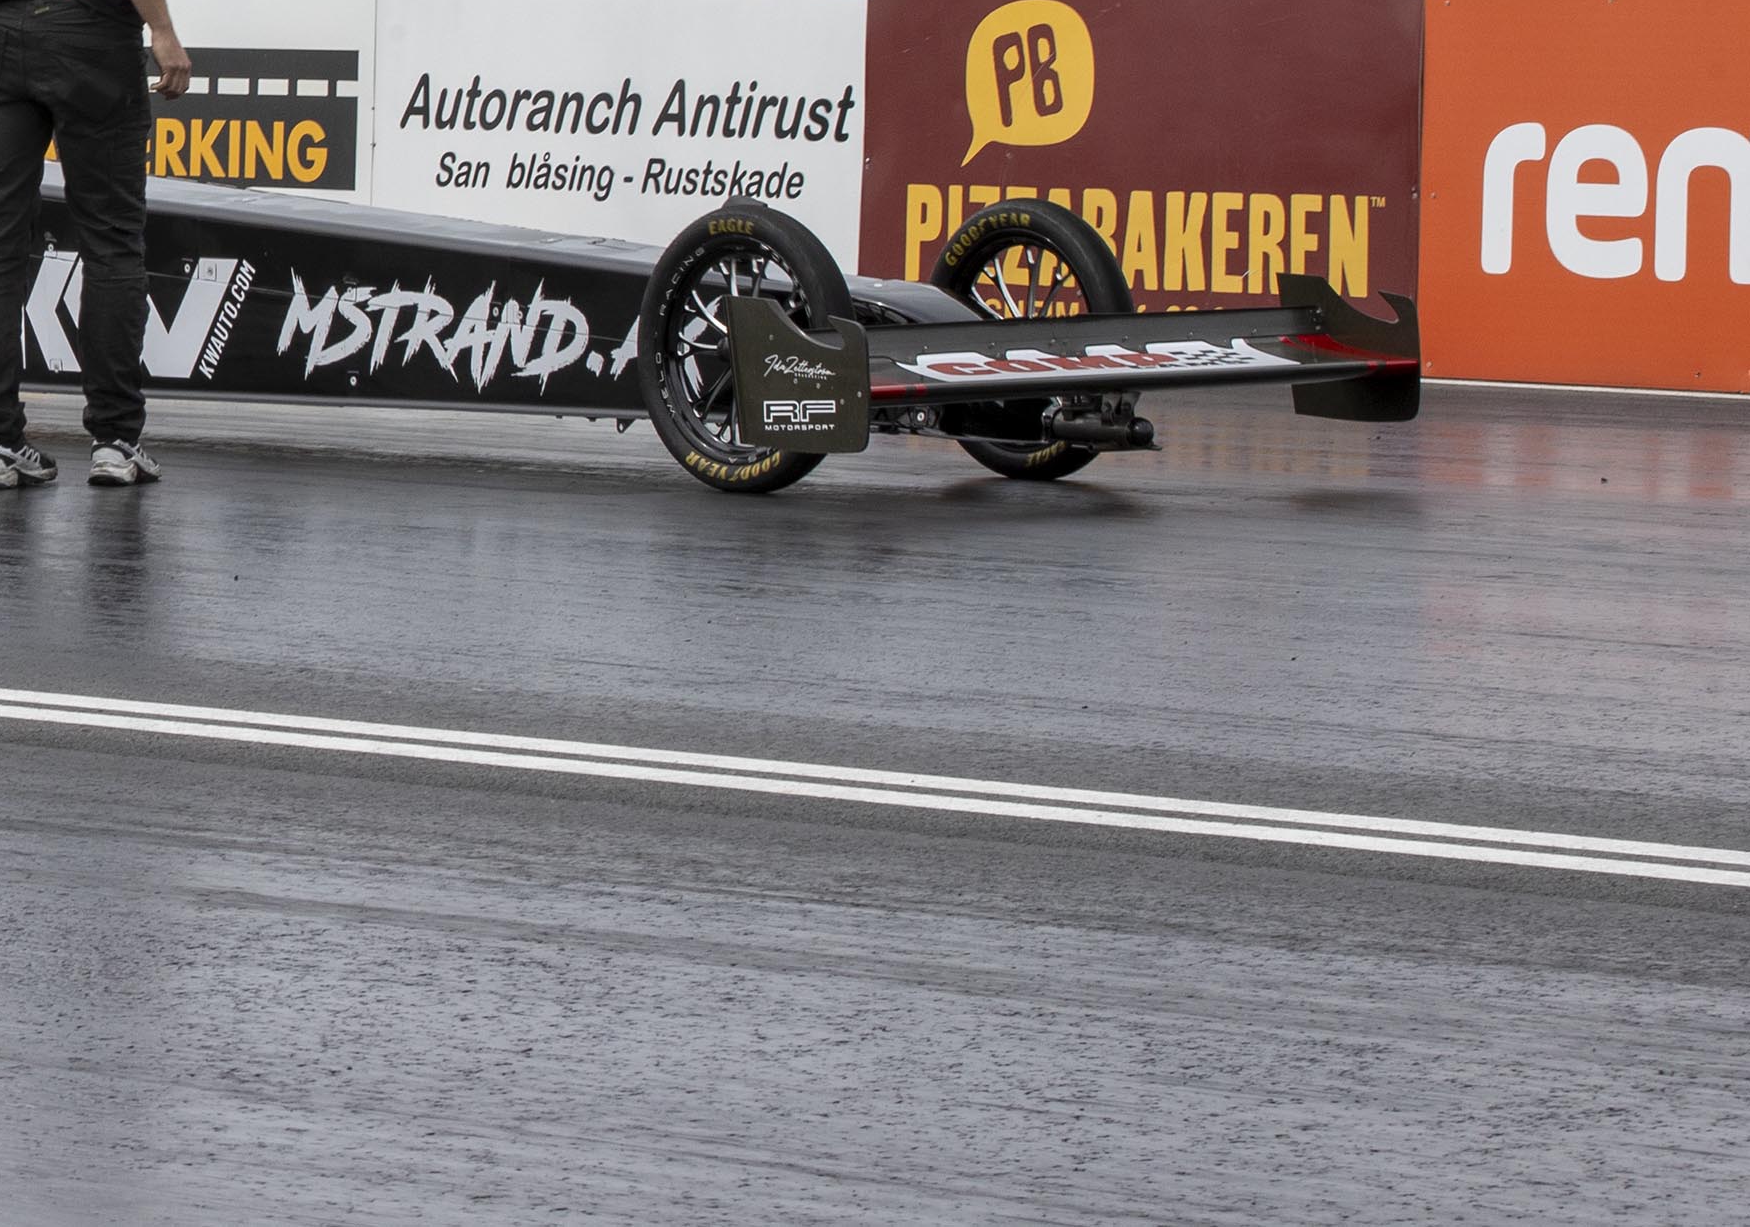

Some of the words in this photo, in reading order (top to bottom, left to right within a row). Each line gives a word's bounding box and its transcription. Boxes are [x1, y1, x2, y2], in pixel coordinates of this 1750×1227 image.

[399, 73, 642, 136] Autoranch
[651, 79, 856, 143] Antirust
[993, 23, 1064, 127] PB
[146, 117, 329, 183] RKING
[436, 151, 491, 188] San
[506, 152, 614, 201] blåsing
[641, 157, 805, 199] Rustskade
[708, 217, 754, 236] EAGLE
[198, 258, 256, 380] KWAUTO.COM
[763, 400, 836, 423] RF
